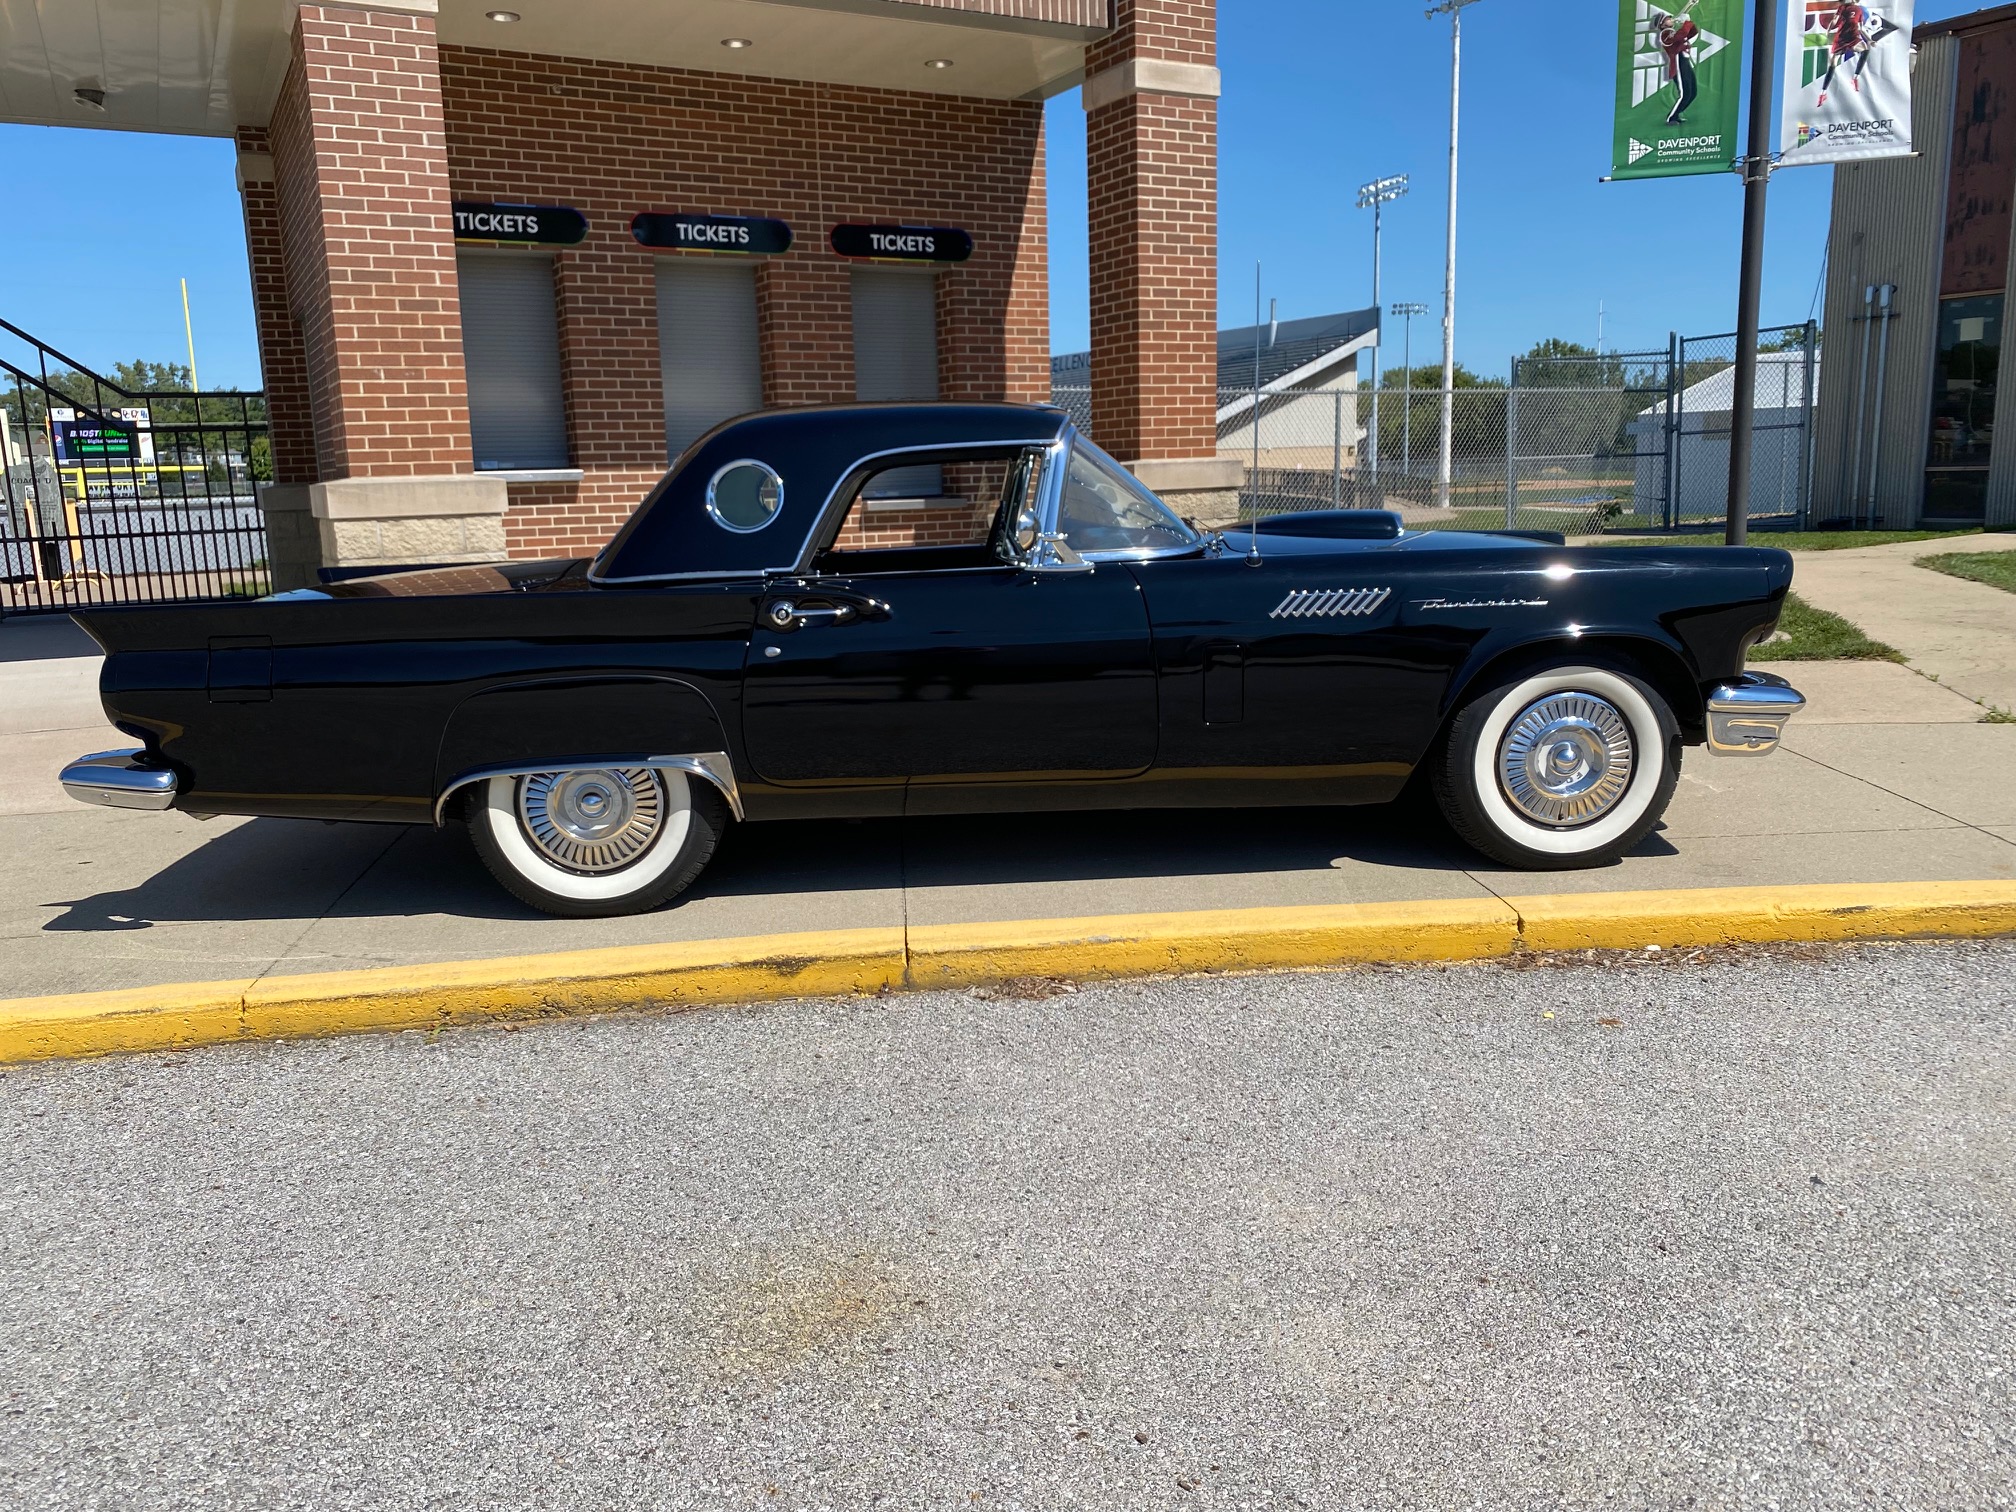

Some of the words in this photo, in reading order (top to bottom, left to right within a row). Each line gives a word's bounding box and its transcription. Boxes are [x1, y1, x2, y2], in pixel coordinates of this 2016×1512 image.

[1828, 119, 1894, 133] DAVENPORT
[1828, 132, 1867, 140] Community
[1867, 129, 1894, 137] Schools
[1658, 135, 1722, 149] DAVENPORT
[1657, 148, 1695, 156] Community
[1695, 145, 1721, 154] Schools
[455, 212, 539, 234] TICKETS
[676, 223, 750, 243] TICKETS
[870, 234, 935, 252] TICKETS
